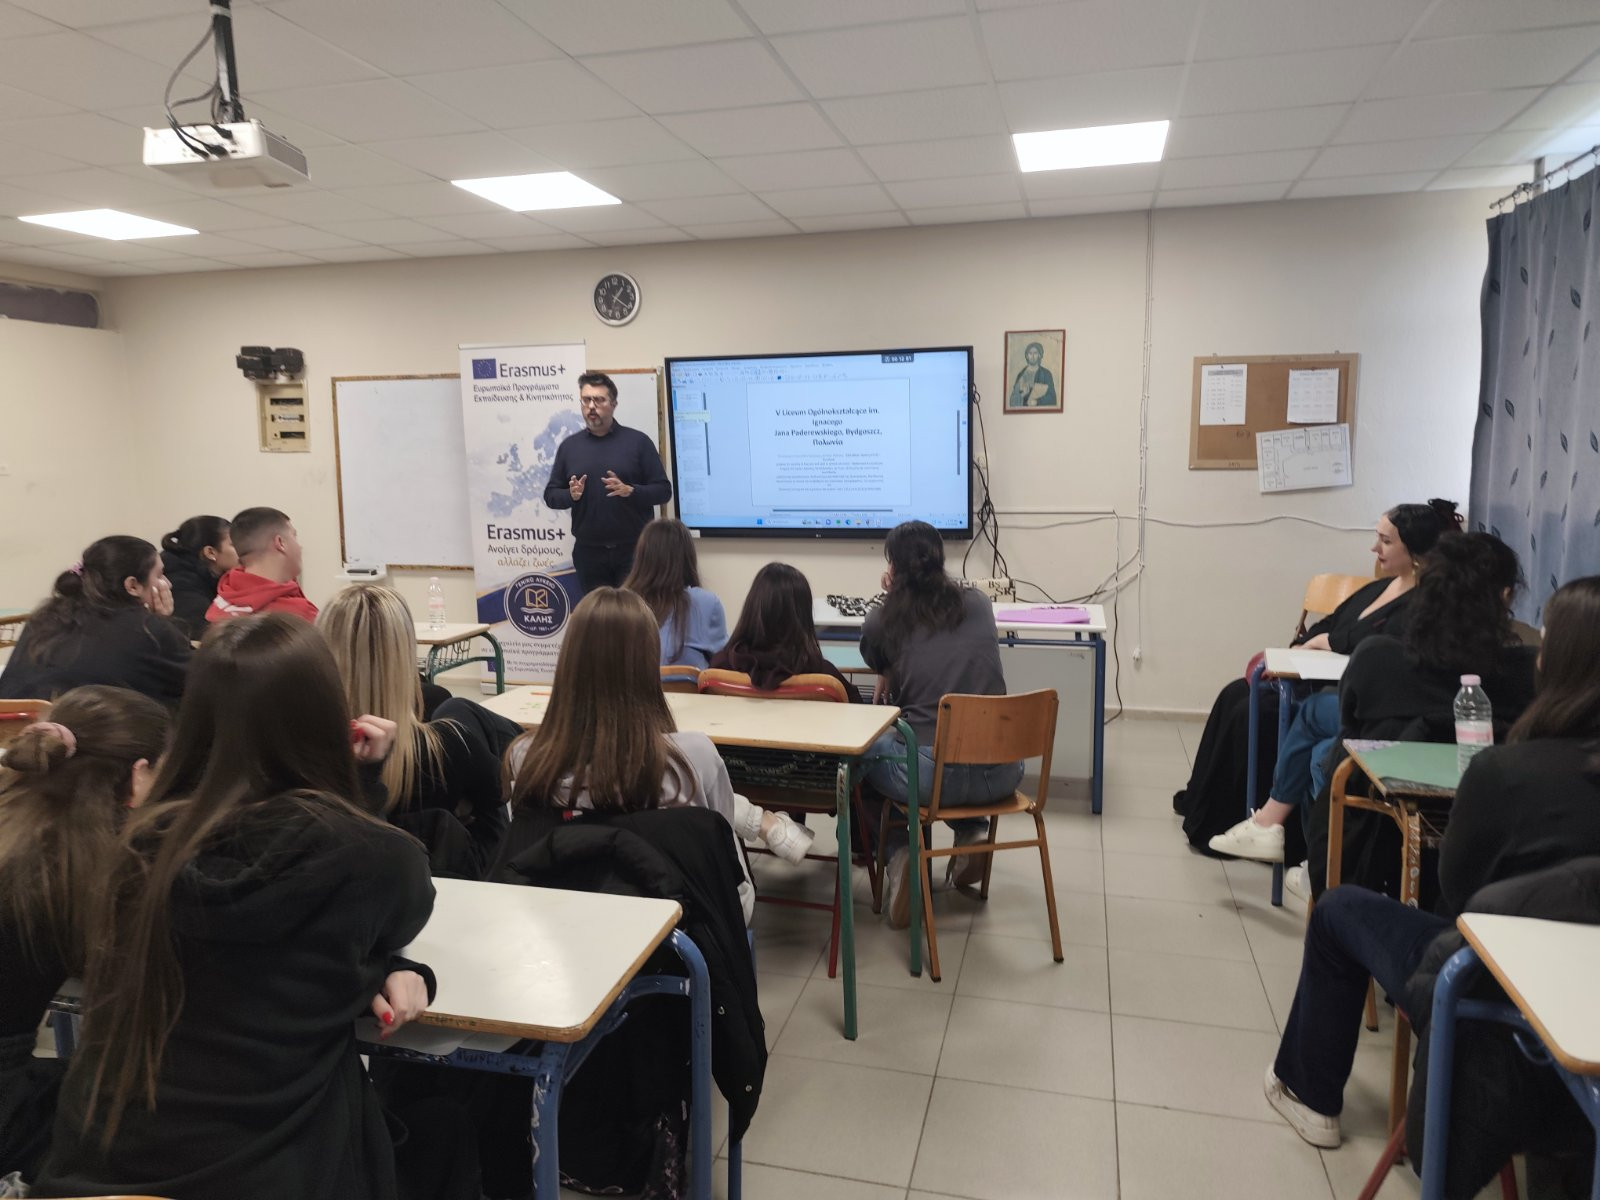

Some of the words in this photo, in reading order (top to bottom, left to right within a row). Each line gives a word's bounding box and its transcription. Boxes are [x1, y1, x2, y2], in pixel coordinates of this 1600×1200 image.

[499, 362, 566, 378] Erasmus+
[512, 383, 560, 393] Προγράμματα
[474, 394, 518, 403] Εκπαίδευσης
[812, 418, 843, 427] Ignacego
[774, 429, 790, 437] Jana
[791, 428, 844, 437] Paderewskiego,
[845, 427, 883, 436] Bydgoszcz,
[812, 438, 844, 447] Πολωνία
[487, 524, 566, 540] Erasmus+
[487, 544, 519, 555] Ανοίγει
[520, 544, 564, 557] δρόμους,
[514, 577, 535, 590] ΓΕΝΙΚΟ
[535, 577, 556, 590] ΛΥΚΕΙΟ
[523, 615, 553, 624] ΚΑΛΗΣ
